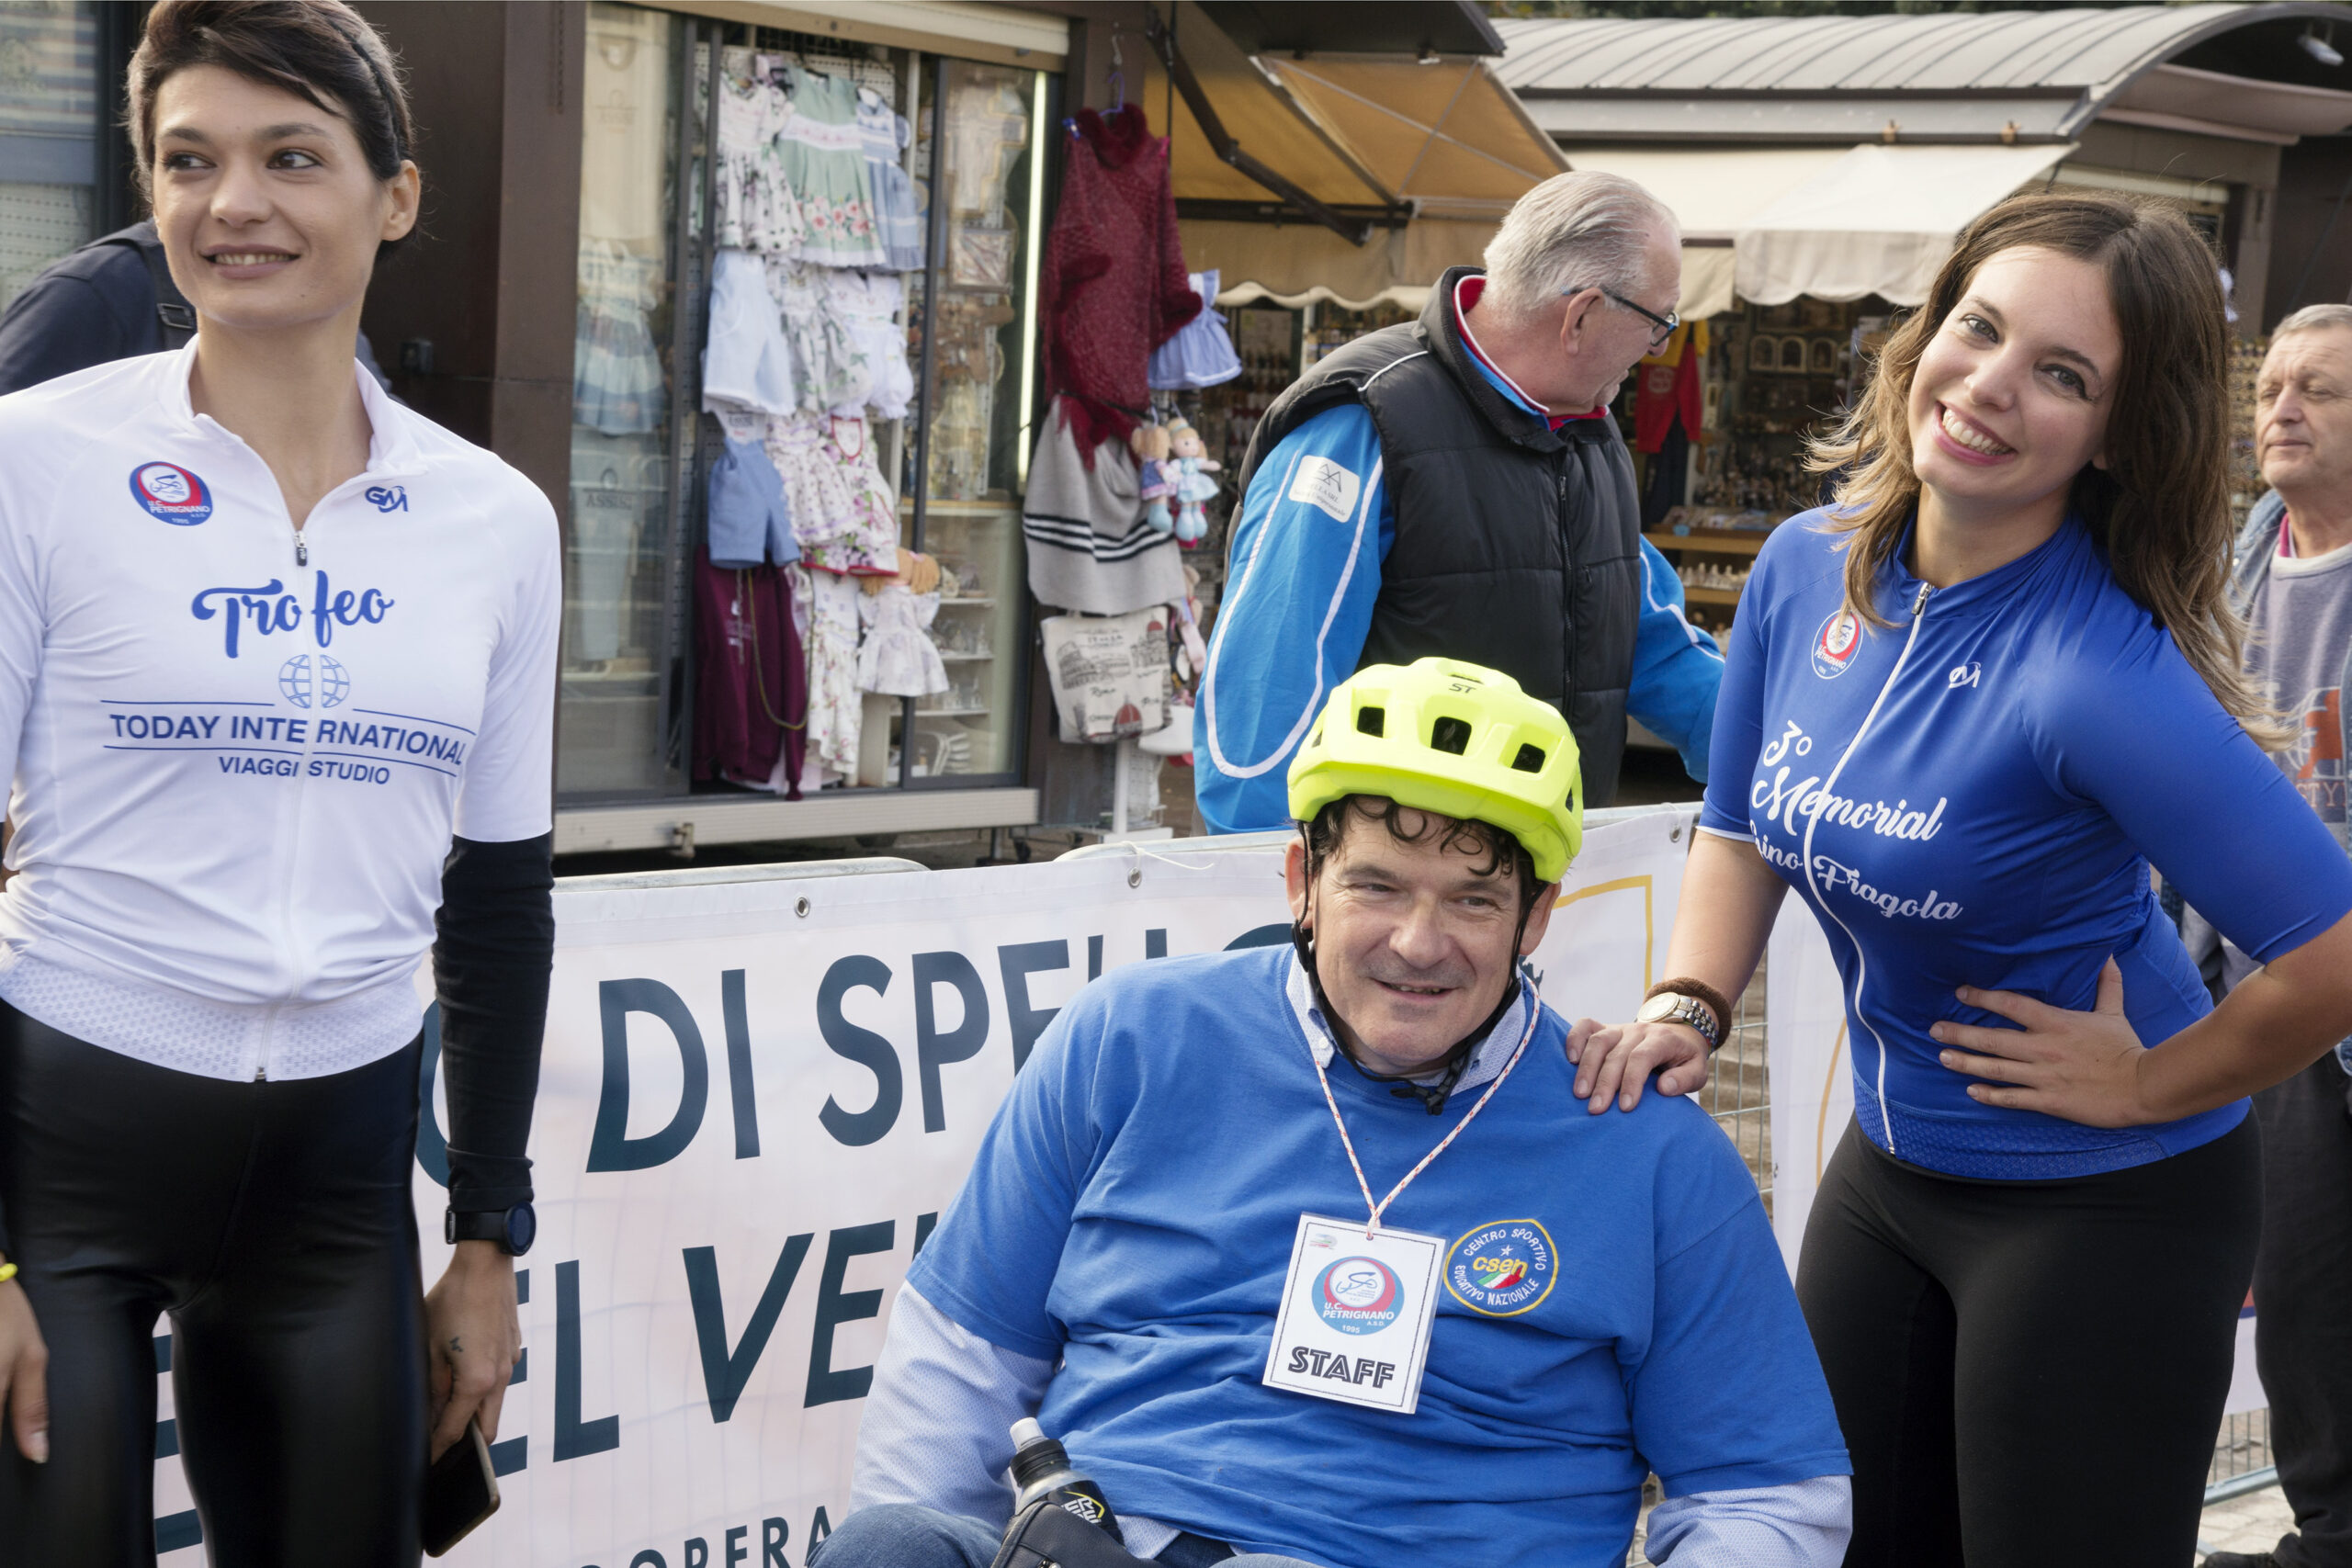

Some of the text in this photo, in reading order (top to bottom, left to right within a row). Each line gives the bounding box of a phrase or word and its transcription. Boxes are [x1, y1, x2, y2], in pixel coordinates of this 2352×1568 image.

[191, 570, 395, 659] Trofeo
[1449, 682, 1476, 694] ST
[109, 713, 467, 766] TODAY INTERNATIONAL
[218, 755, 390, 785] VIAGGI STUDIO
[1751, 766, 1948, 841] Memorial
[1813, 854, 1964, 919] Fragola
[585, 967, 762, 1174] DI
[1464, 1228, 1547, 1271] CENTRO SPORTIVO
[1472, 1256, 1529, 1279] csen
[1487, 1278, 1540, 1305] NAZIONALE
[682, 1211, 939, 1425] VE
[1322, 1310, 1395, 1321] PETRIGNANO
[1342, 1325, 1361, 1334] 1995
[1287, 1346, 1396, 1389] STAFF
